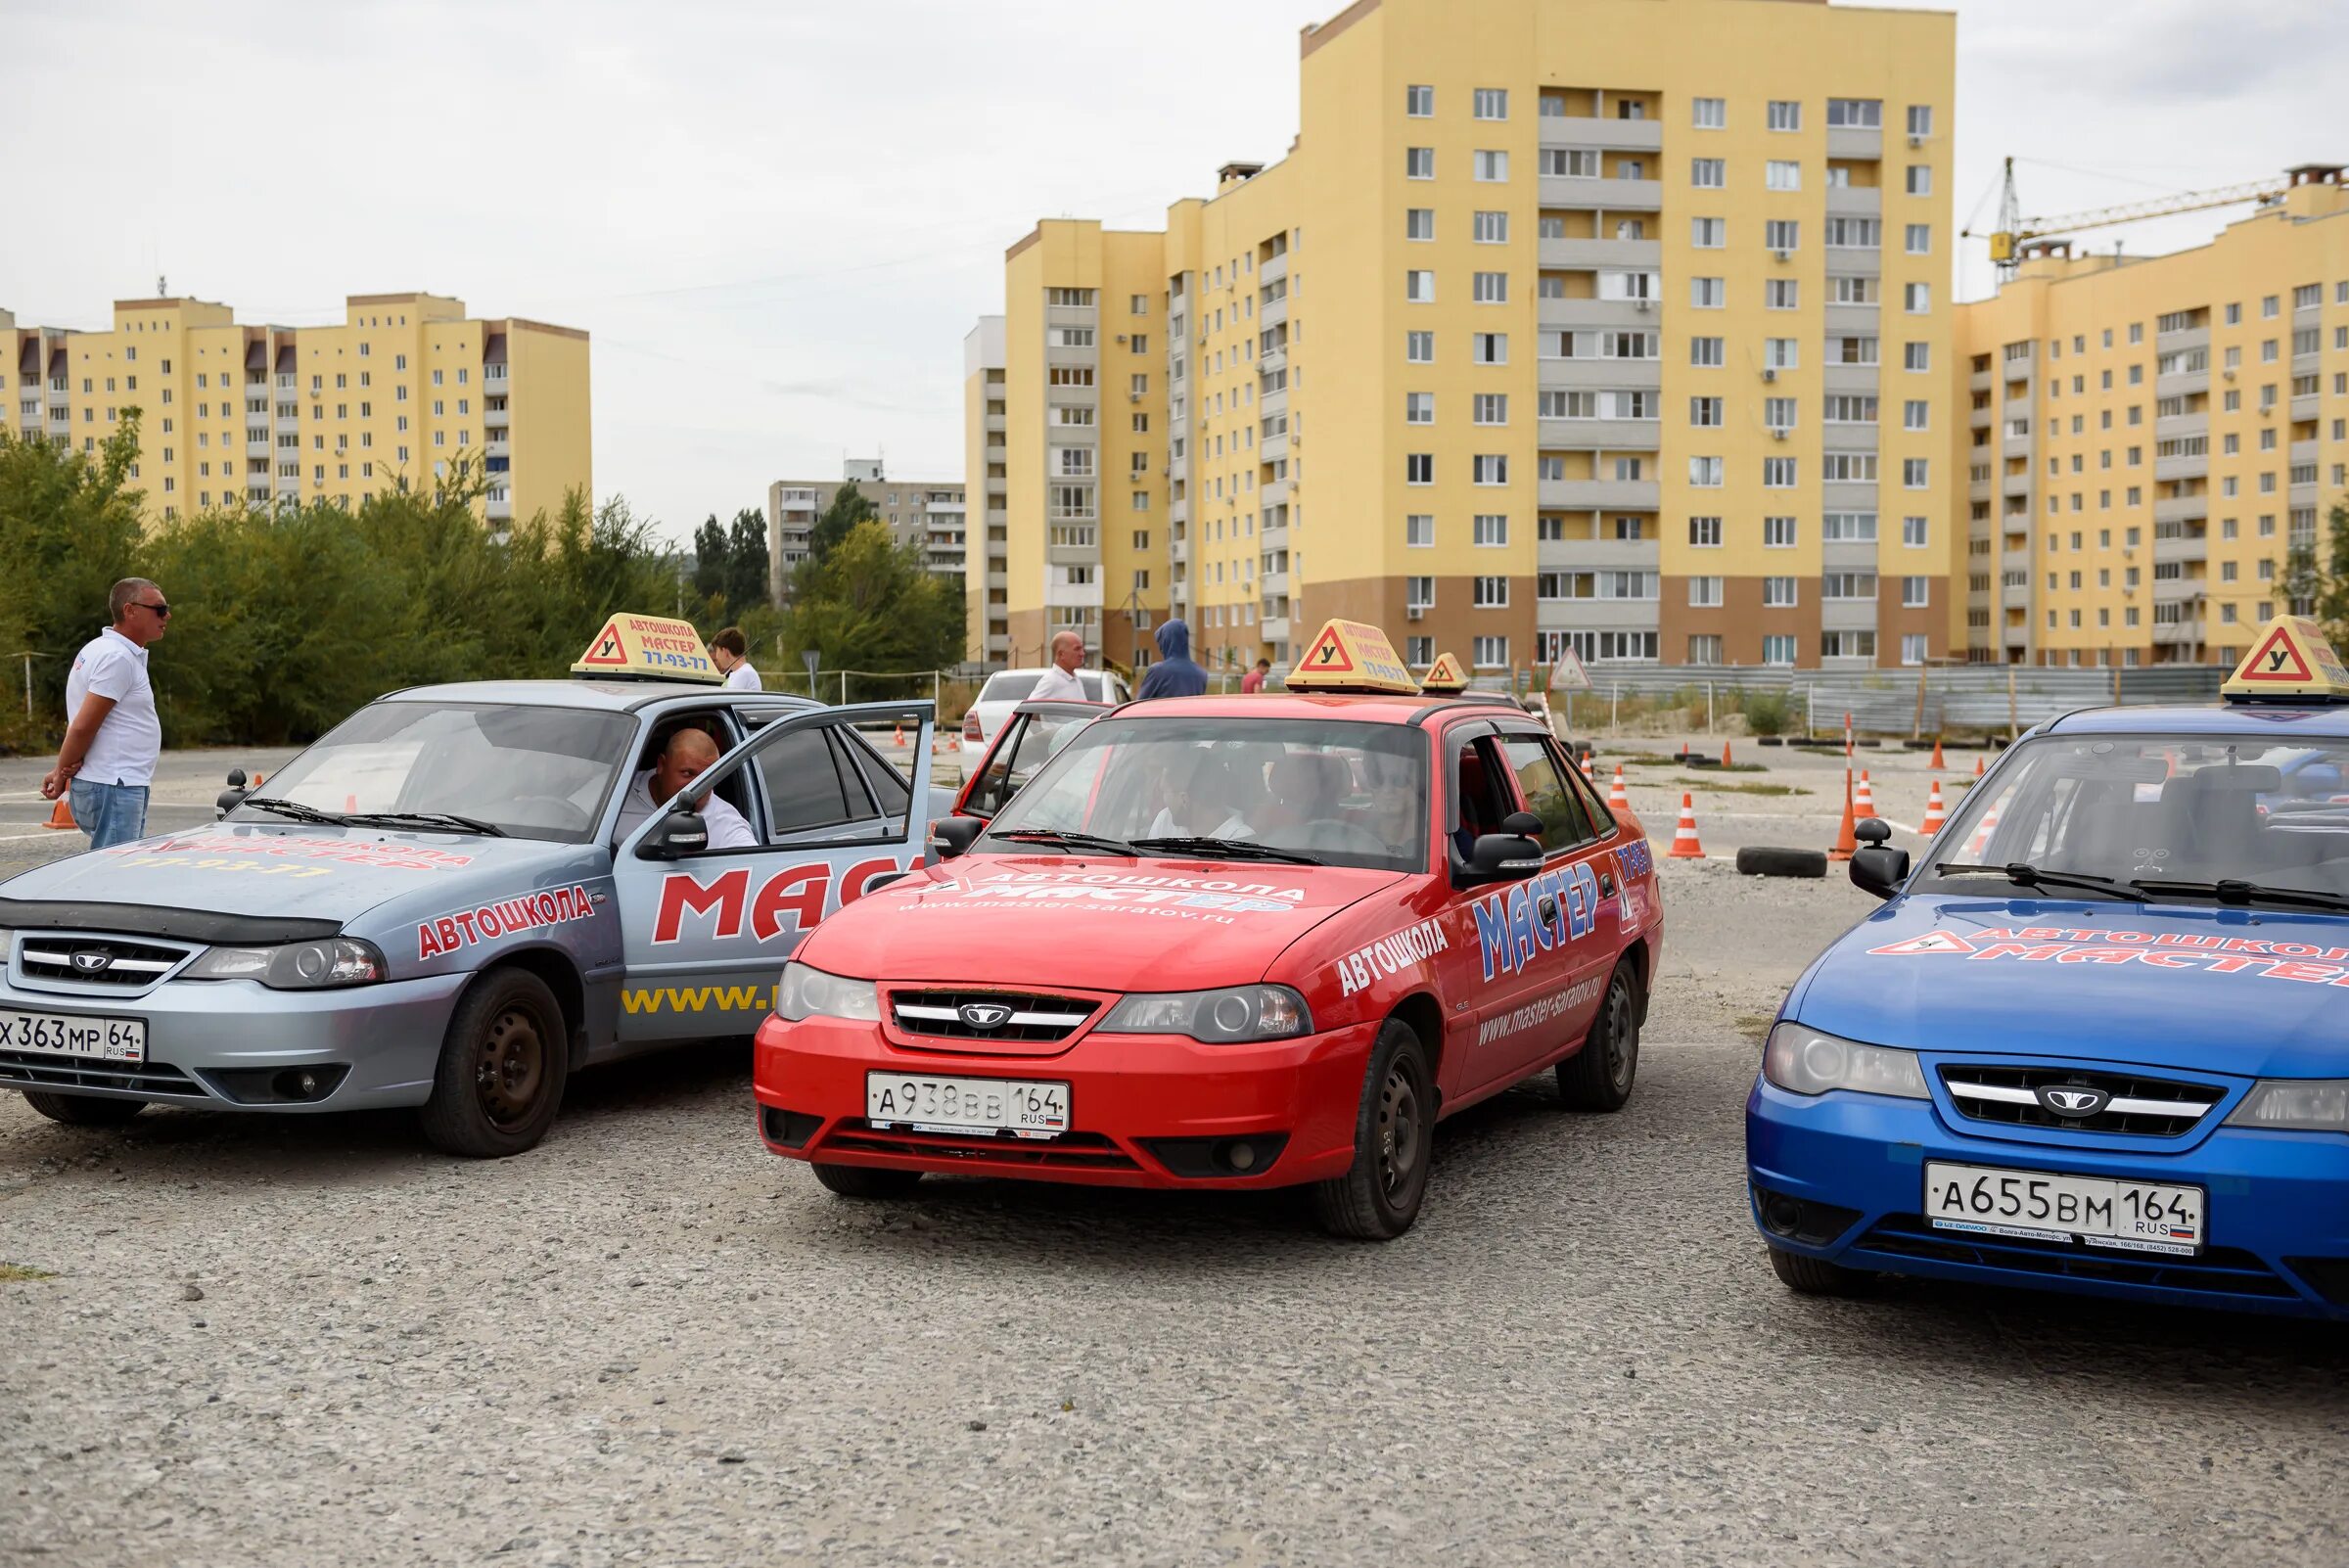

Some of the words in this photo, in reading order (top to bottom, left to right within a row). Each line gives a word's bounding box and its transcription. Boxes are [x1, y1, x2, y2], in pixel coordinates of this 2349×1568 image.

[629, 620, 695, 637] АВТОШКОЛА
[601, 641, 615, 656] У
[641, 636, 696, 653] МАСТЕР
[1321, 646, 1336, 664] У
[642, 651, 708, 670] 77-93-77
[2269, 651, 2288, 671] У
[960, 884, 1294, 912] МАСТЕР
[980, 873, 1306, 901] АВТОШКОЛА
[418, 885, 596, 961] АВТОШКОЛА
[898, 899, 1236, 925] www.master-saratov.ru
[1471, 861, 1599, 984] МАСТЕР
[1337, 918, 1450, 997] АВТОШКОЛА
[1479, 976, 1602, 1046] www.master-saratov.ru
[109, 1023, 134, 1047] 64
[107, 1046, 125, 1056] RUS
[1011, 1087, 1057, 1114] 164
[1021, 1114, 1045, 1124] RUS
[2123, 1188, 2187, 1223] 164
[2136, 1222, 2168, 1235] RUS
